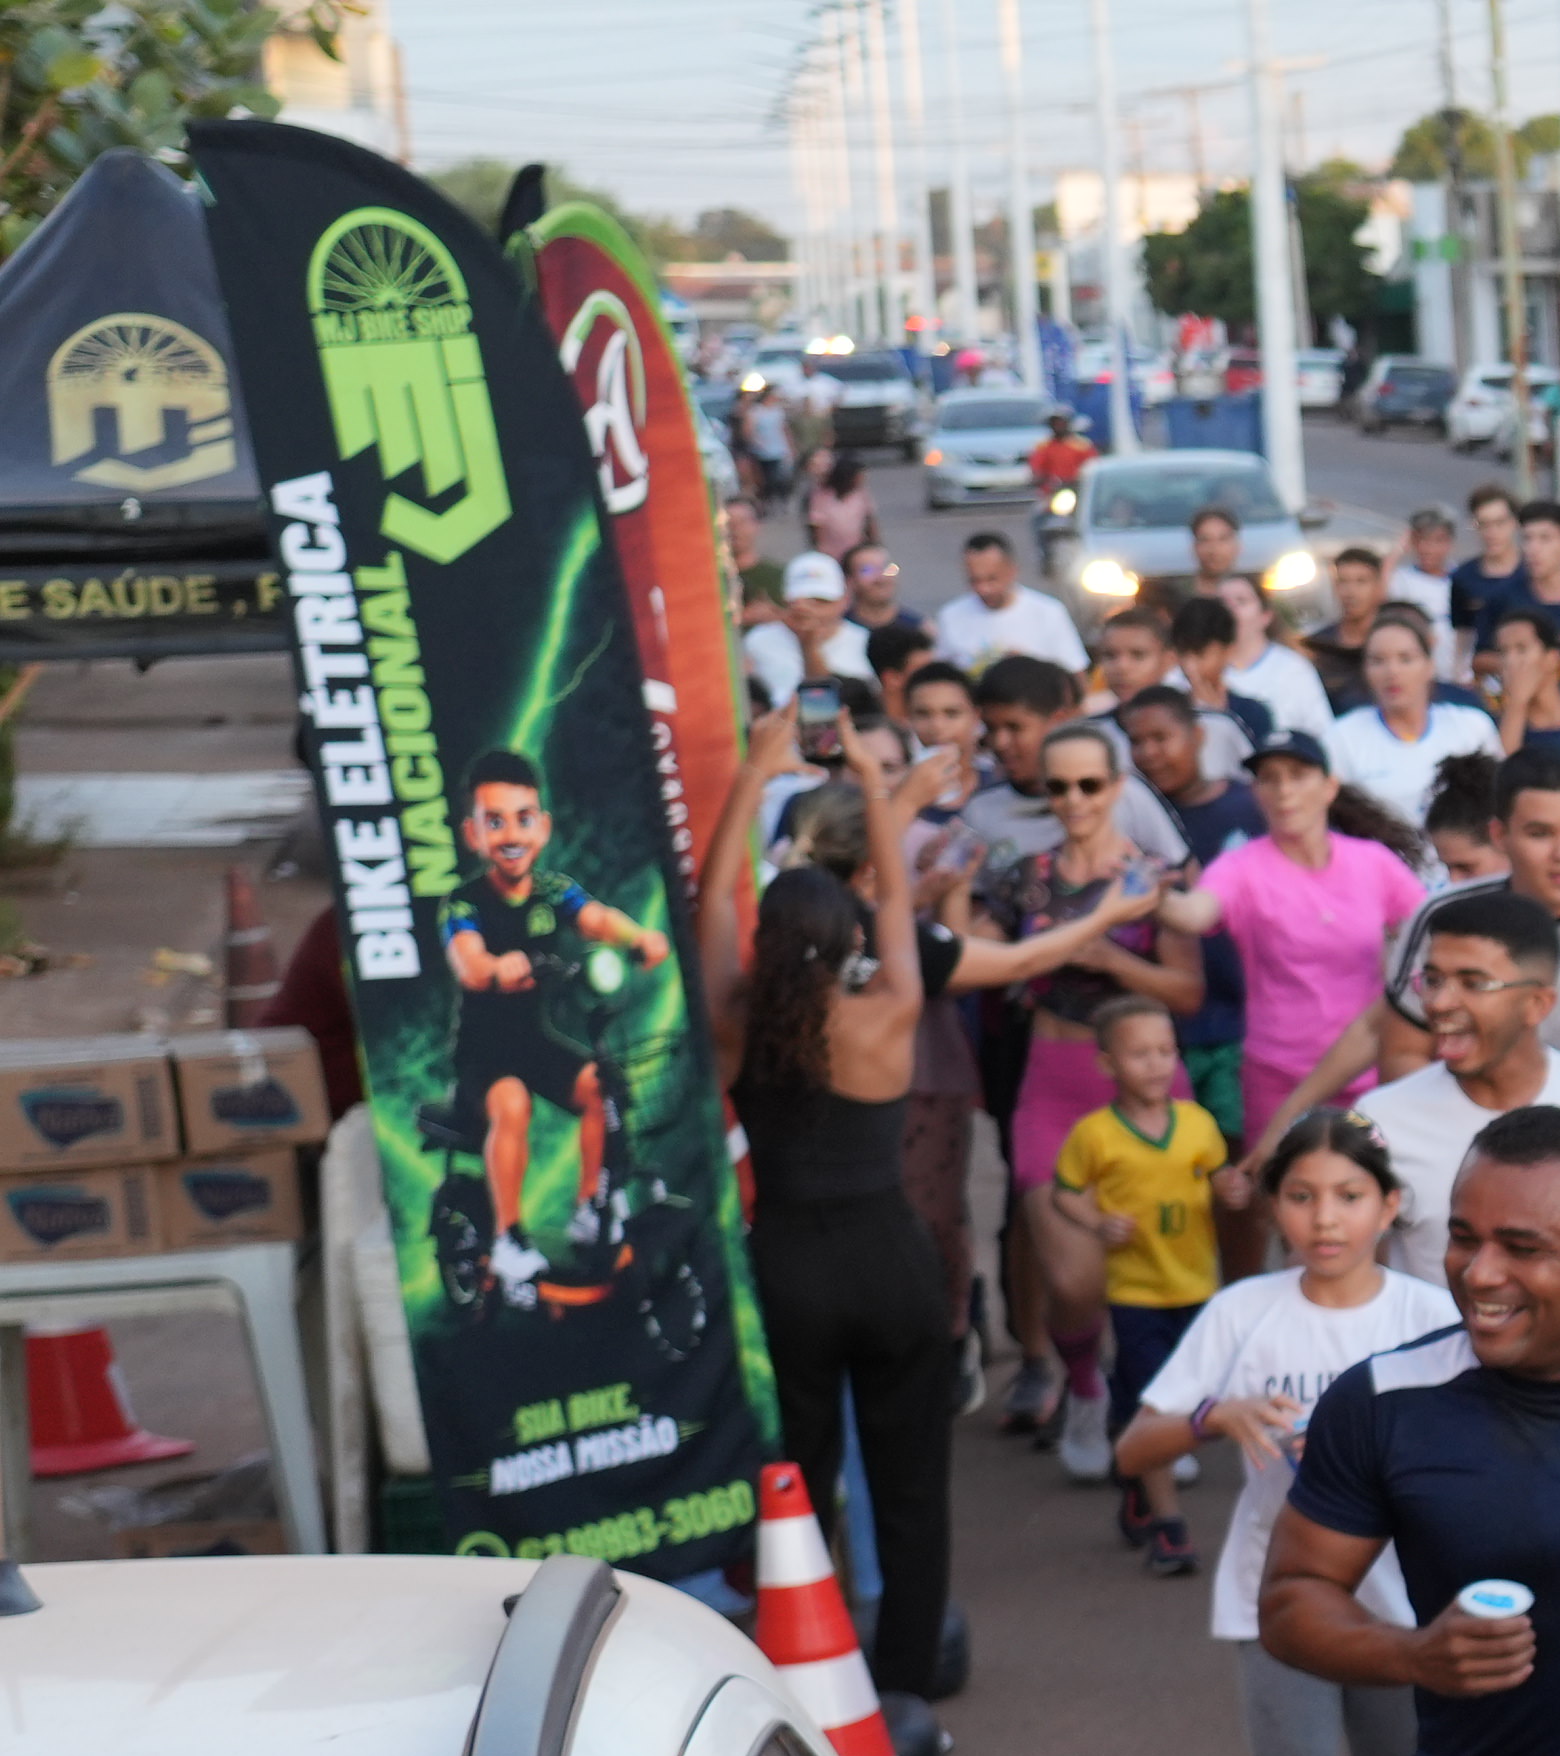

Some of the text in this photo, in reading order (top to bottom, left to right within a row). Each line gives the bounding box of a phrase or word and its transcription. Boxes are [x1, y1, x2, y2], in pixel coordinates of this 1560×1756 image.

[41, 567, 219, 619] SAÚDE
[271, 470, 421, 980] BIKE ELÉTRICA
[354, 549, 462, 898] NACIONAL
[489, 1412, 680, 1496] NOSSA MISSÃO
[514, 1399, 567, 1445] SUA
